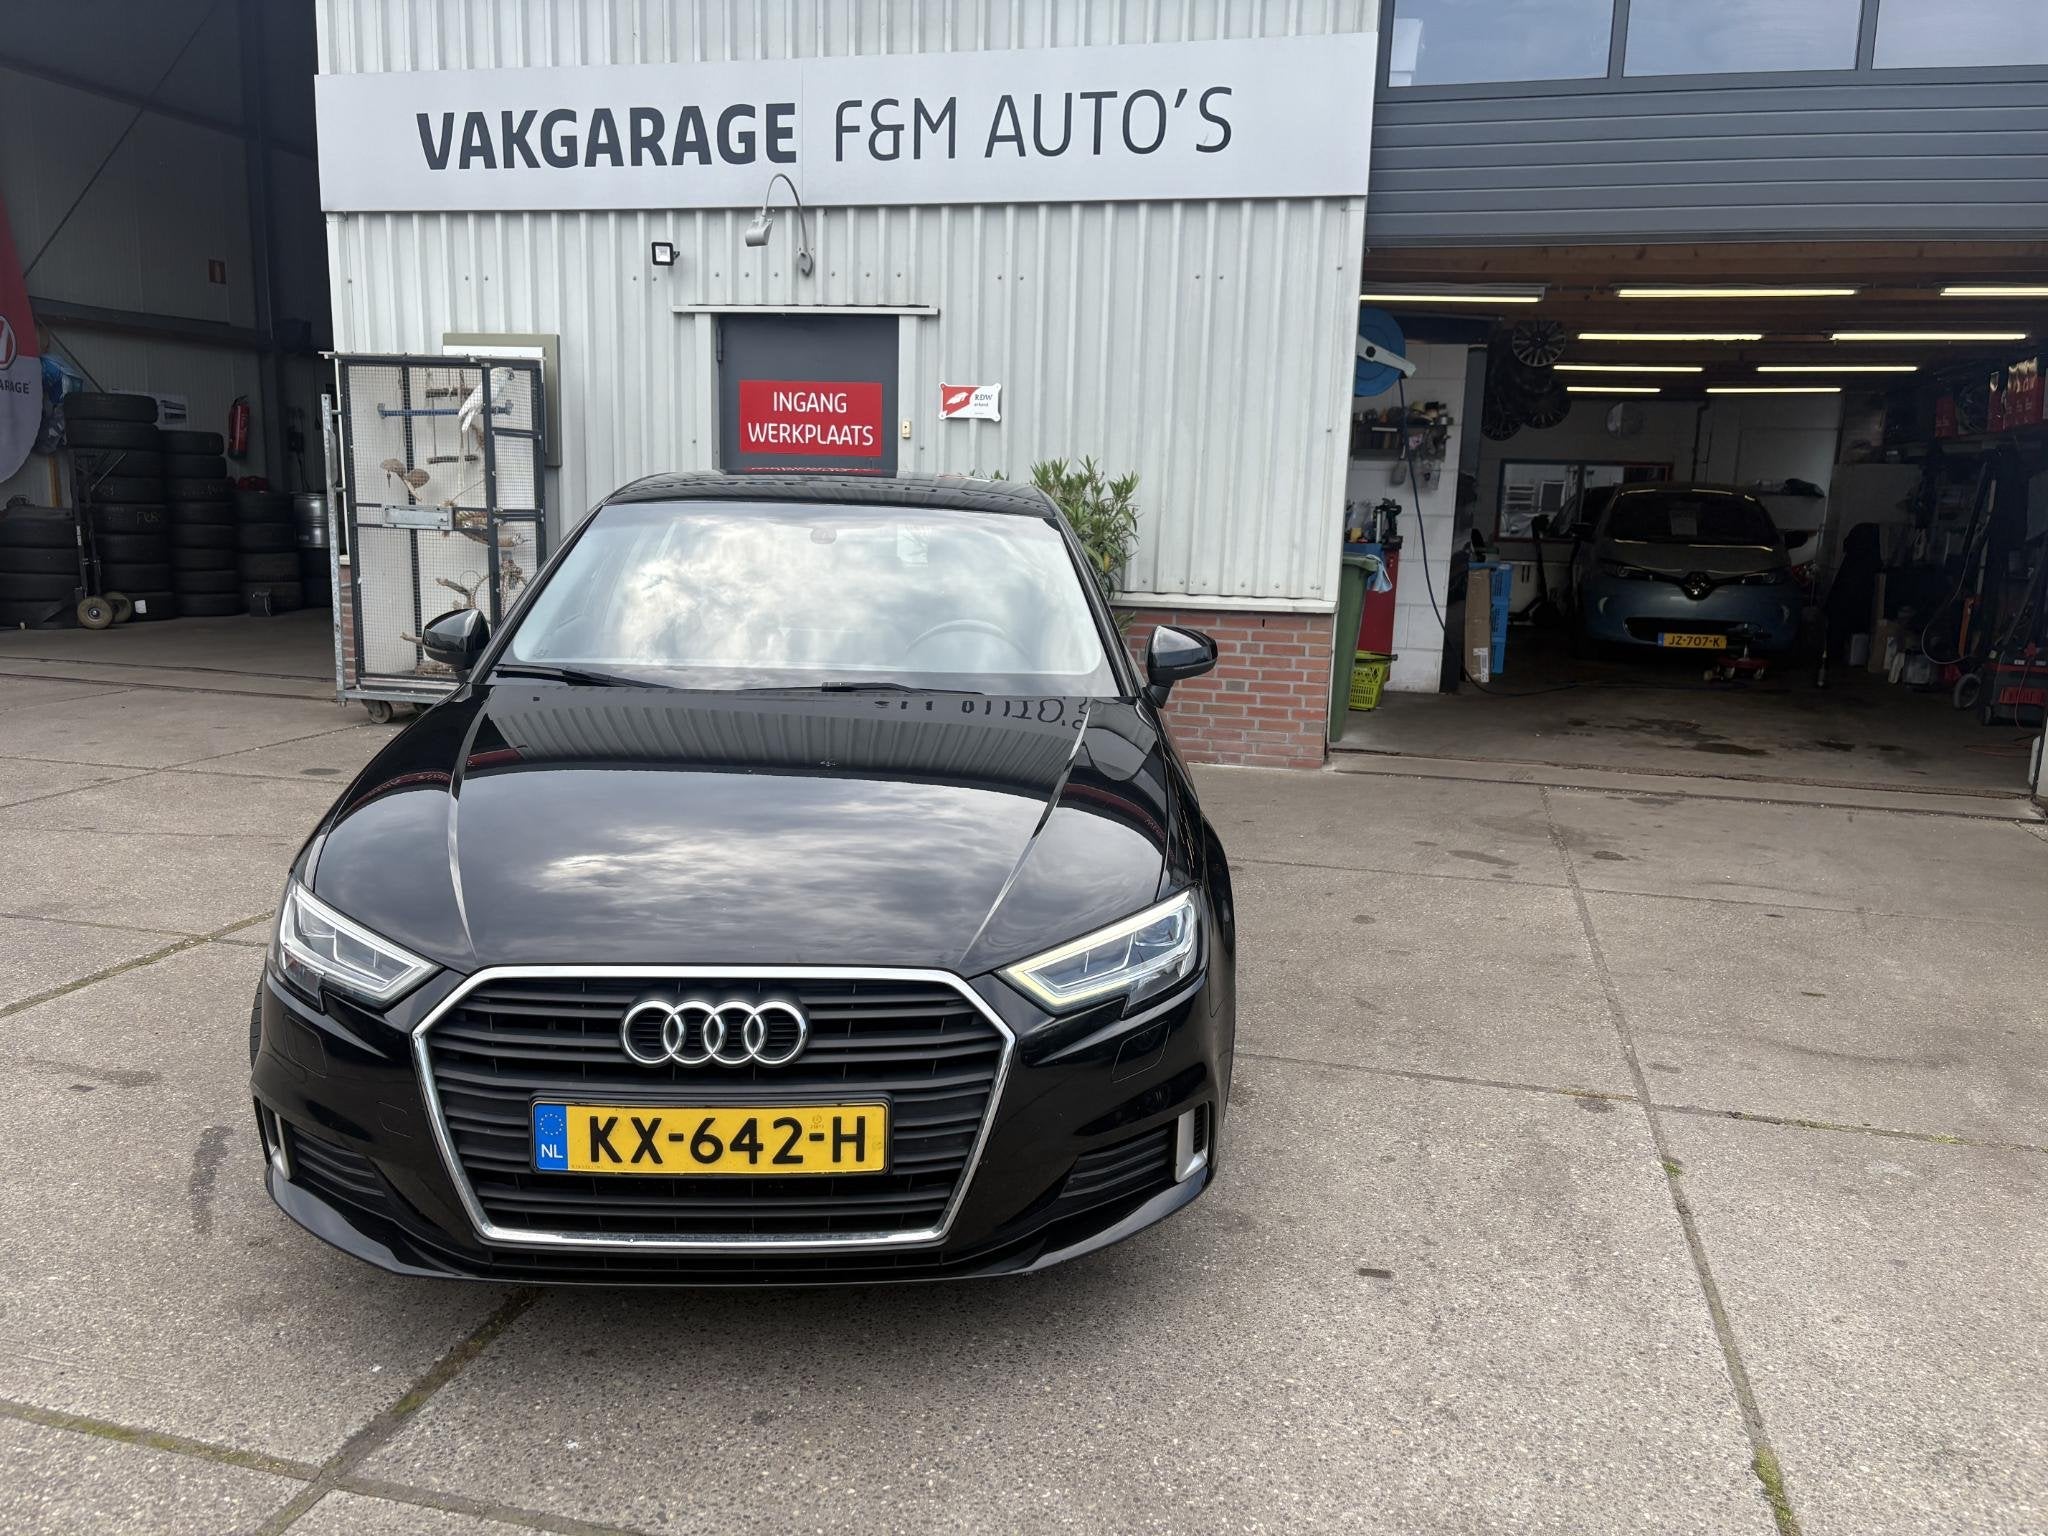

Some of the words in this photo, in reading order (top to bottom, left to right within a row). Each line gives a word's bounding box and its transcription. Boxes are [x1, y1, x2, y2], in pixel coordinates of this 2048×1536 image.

[416, 102, 797, 170] VAKGARAGE
[835, 96, 957, 162] F&M
[984, 86, 1232, 159] AUTO'S
[773, 391, 848, 414] INGANG
[747, 422, 874, 446] WERKPLAATS
[1668, 635, 1721, 647] JZ-707-K
[541, 1145, 563, 1159] NL
[589, 1115, 866, 1165] KX-642-H
